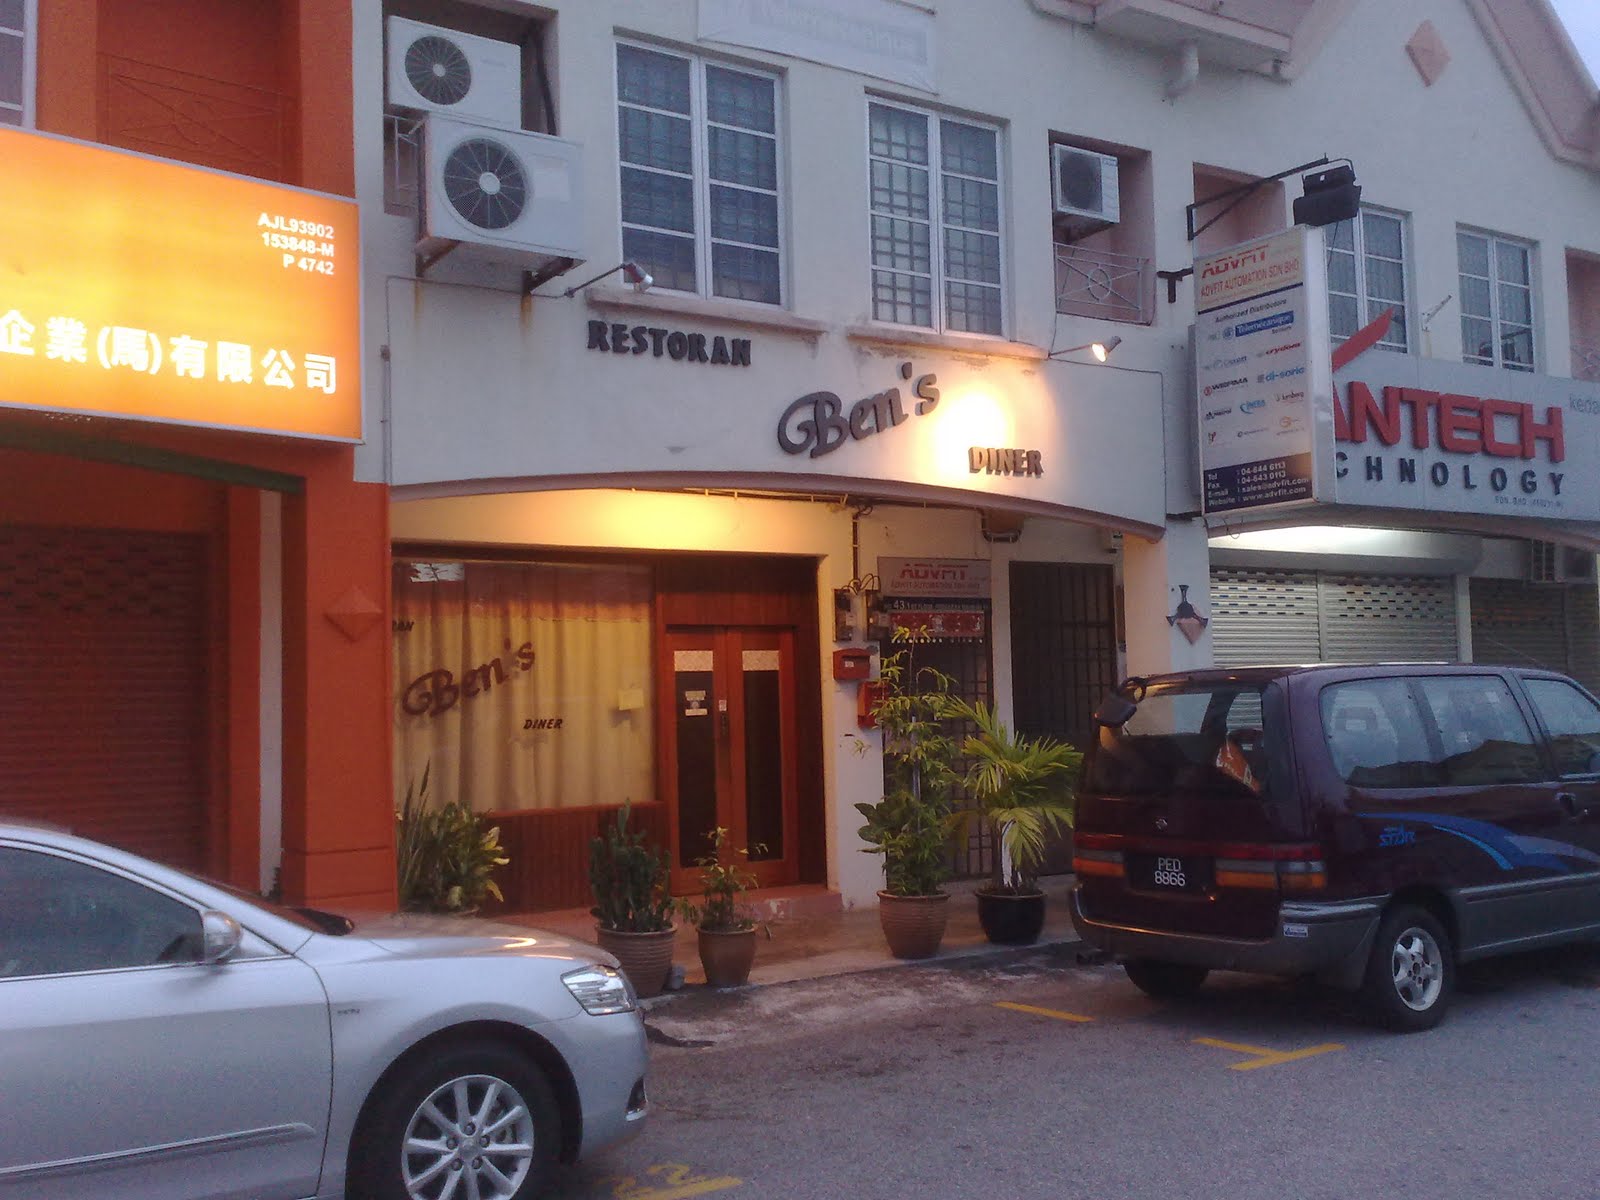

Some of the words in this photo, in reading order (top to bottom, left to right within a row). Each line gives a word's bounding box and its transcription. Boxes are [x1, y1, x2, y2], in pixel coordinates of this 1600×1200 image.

[258, 213, 334, 239] AJL93902
[283, 254, 295, 268] P
[298, 257, 334, 275] 4742
[587, 320, 752, 367] RESTORAN
[777, 362, 940, 459] Ben's
[968, 446, 1044, 478] DINER
[402, 638, 535, 718] Ben's
[523, 718, 563, 730] DINER
[1158, 857, 1181, 872] PED
[1154, 871, 1186, 887] 8866
